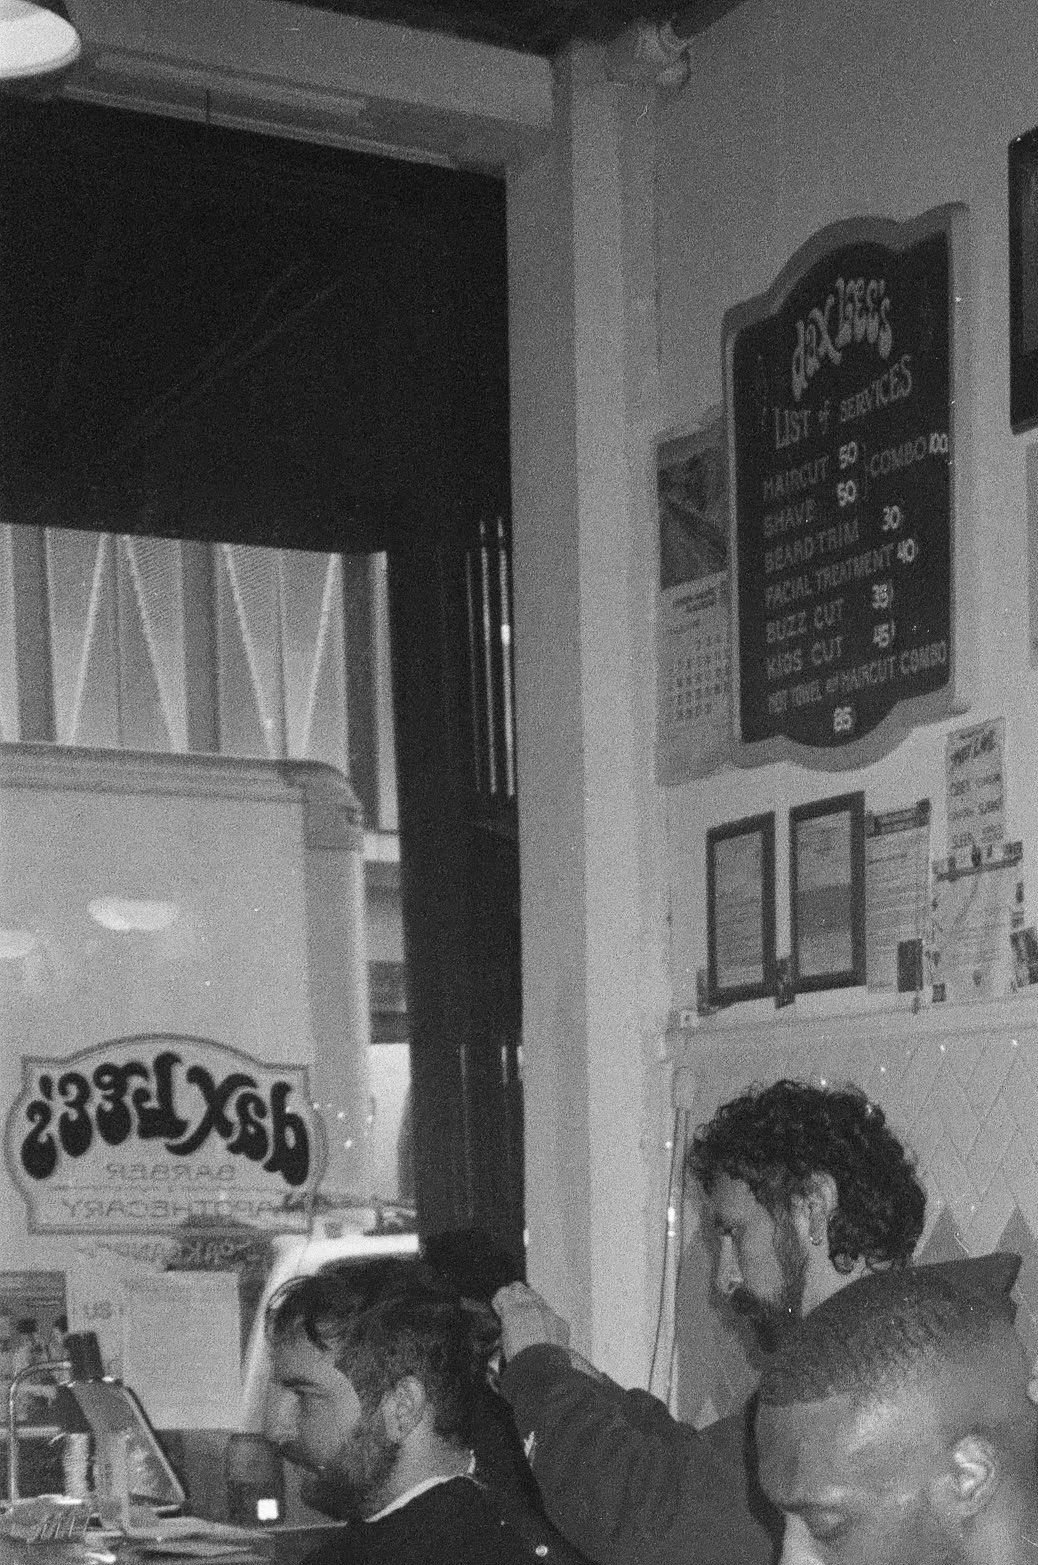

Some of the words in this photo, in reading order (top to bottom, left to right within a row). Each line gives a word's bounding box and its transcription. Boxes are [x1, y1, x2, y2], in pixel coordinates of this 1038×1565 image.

[773, 407, 811, 450] LIST
[841, 354, 913, 423] SERVICES
[763, 454, 829, 502] HAIRCUT
[838, 440, 858, 469] 50
[869, 434, 927, 478] COMBO
[929, 431, 949, 455] 100
[763, 498, 816, 539] SHAVE
[837, 479, 858, 507] 50
[764, 534, 815, 574] BEARD
[816, 518, 859, 555] TRIM
[765, 574, 812, 609] FACIAL
[814, 542, 896, 592] TREATMENT
[896, 537, 918, 565] 40
[766, 609, 807, 644] BUZZ
[813, 600, 844, 629] CUT
[766, 649, 803, 681] KIDS
[809, 635, 844, 666] CUT
[841, 655, 897, 692] HAIRCUT
[899, 639, 948, 675] COMBO
